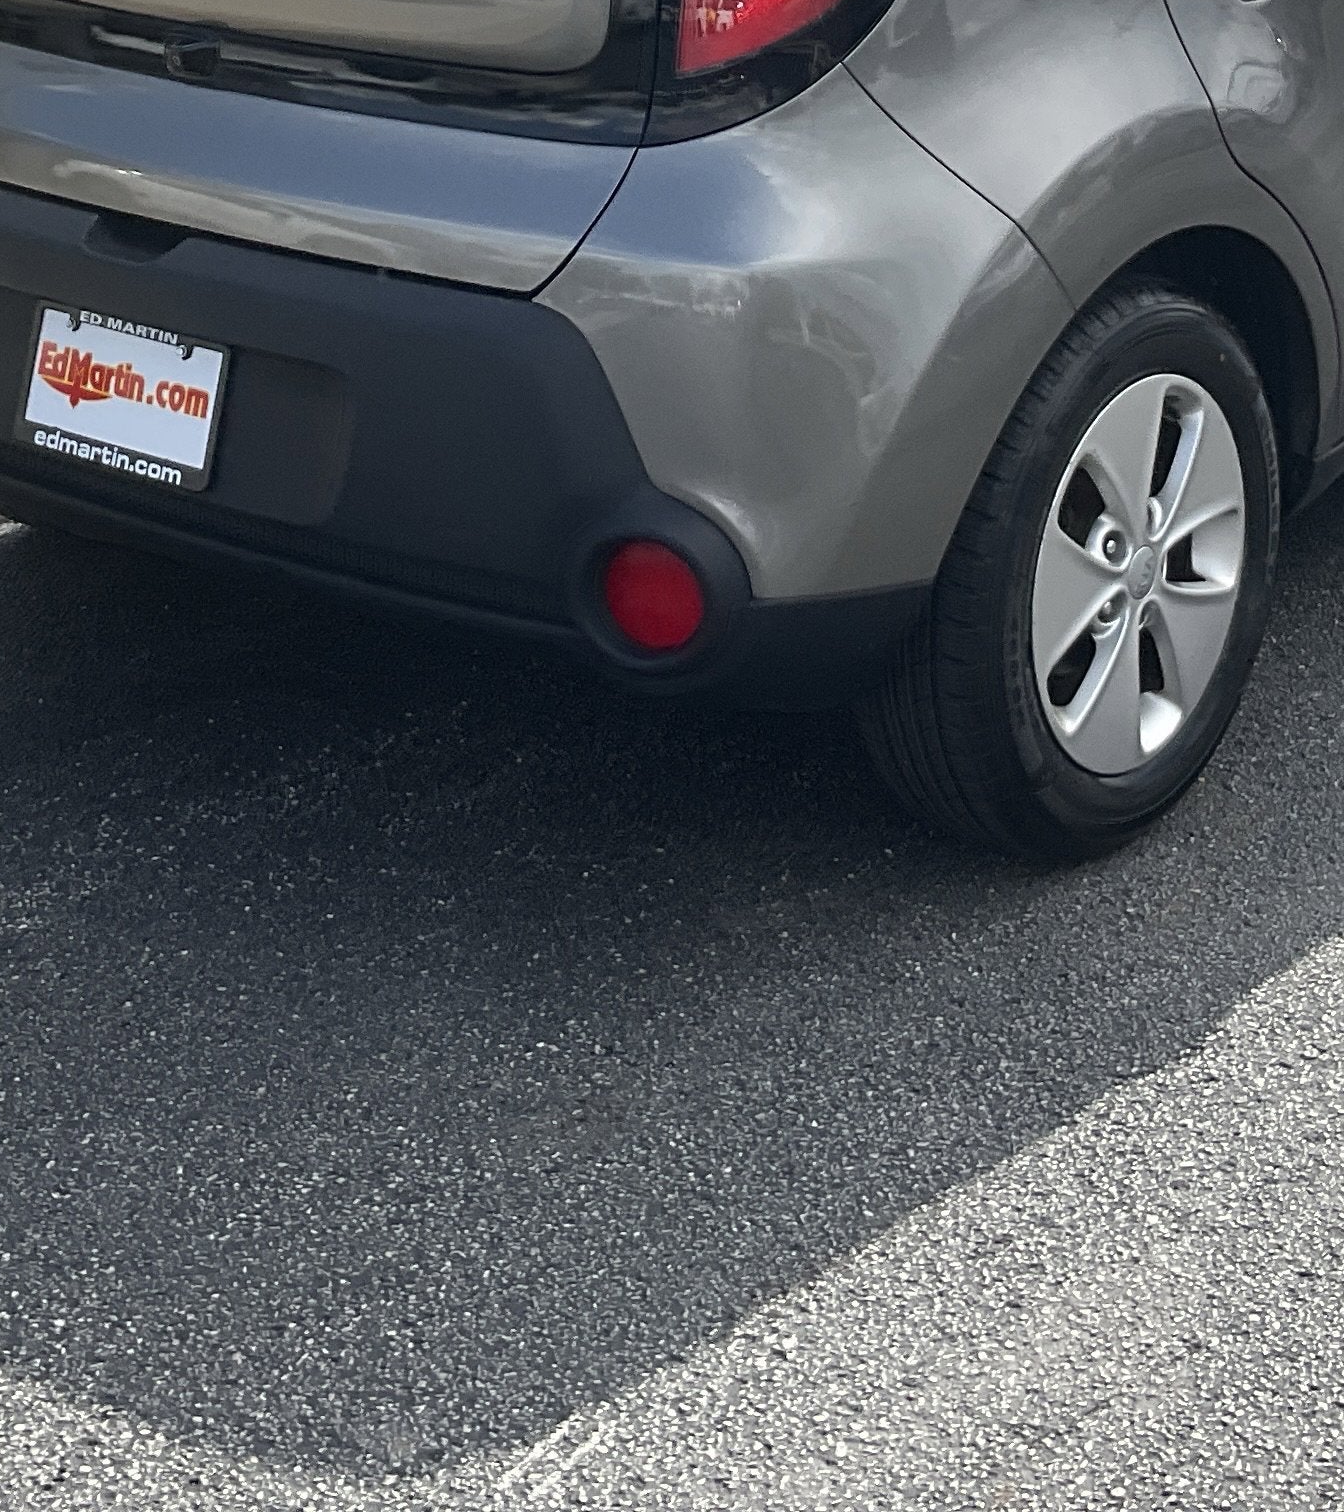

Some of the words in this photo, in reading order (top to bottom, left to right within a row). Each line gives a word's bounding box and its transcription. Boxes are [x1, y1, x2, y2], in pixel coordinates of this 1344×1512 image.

[79, 310, 102, 326] ED
[107, 317, 179, 345] MARTIN
[33, 429, 183, 486] edmartin.com
